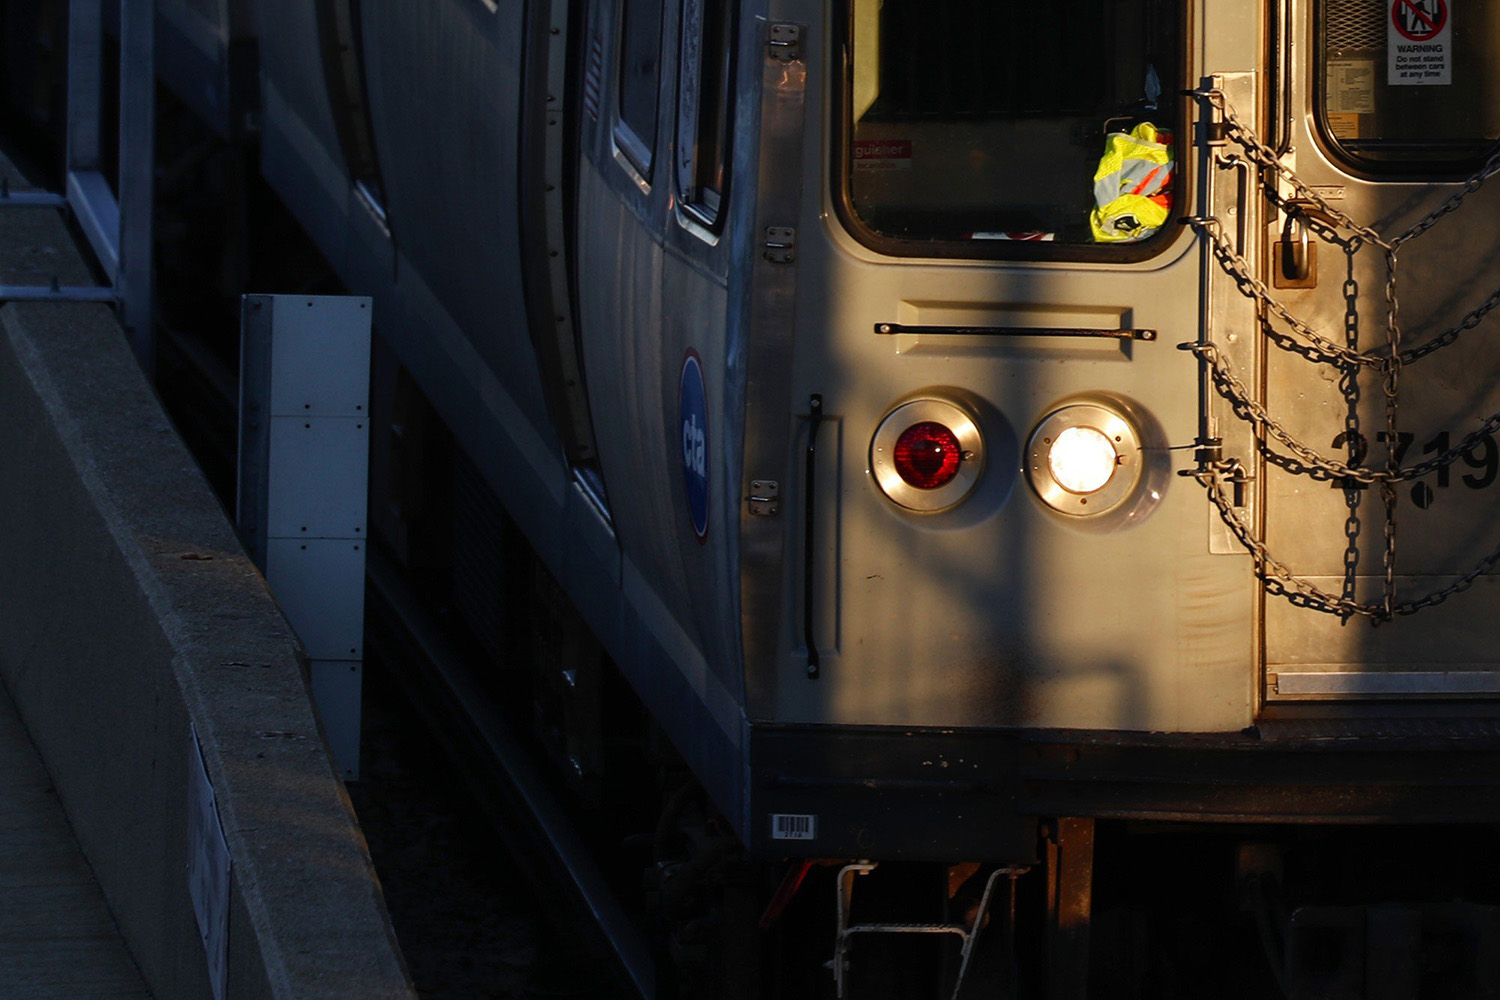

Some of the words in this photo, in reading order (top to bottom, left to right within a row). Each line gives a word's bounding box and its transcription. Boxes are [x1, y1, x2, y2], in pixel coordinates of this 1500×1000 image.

[1397, 44, 1443, 53] WARNING
[1396, 55, 1408, 63] Do
[1409, 55, 1421, 63] not
[1423, 55, 1444, 63] stand
[1409, 71, 1423, 79] any
[683, 413, 706, 477] cta
[1331, 431, 1499, 490] 2719
